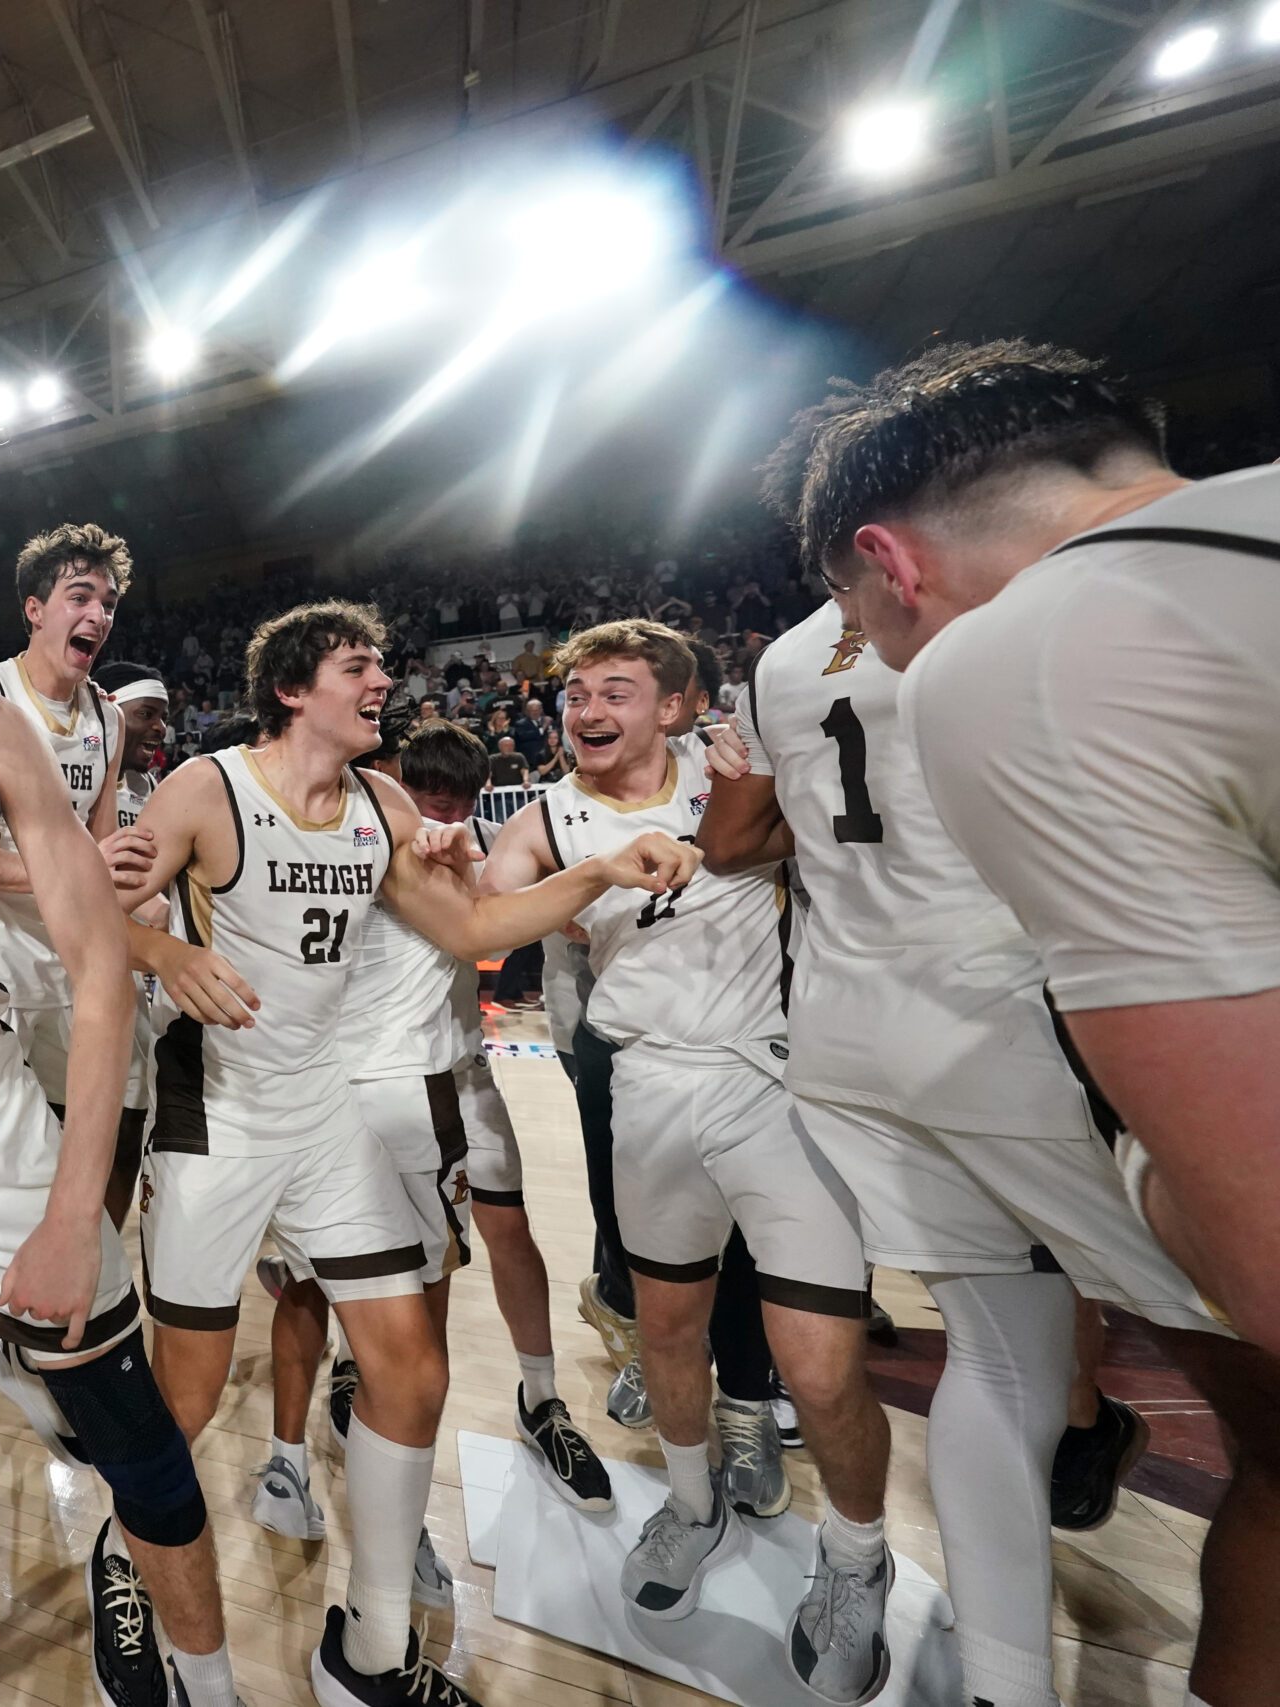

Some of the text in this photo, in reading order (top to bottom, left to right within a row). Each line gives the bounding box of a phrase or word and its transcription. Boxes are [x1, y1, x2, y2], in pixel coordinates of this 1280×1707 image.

[820, 697, 883, 843] 1
[267, 861, 373, 895] LEHIGH
[300, 908, 348, 964] 21
